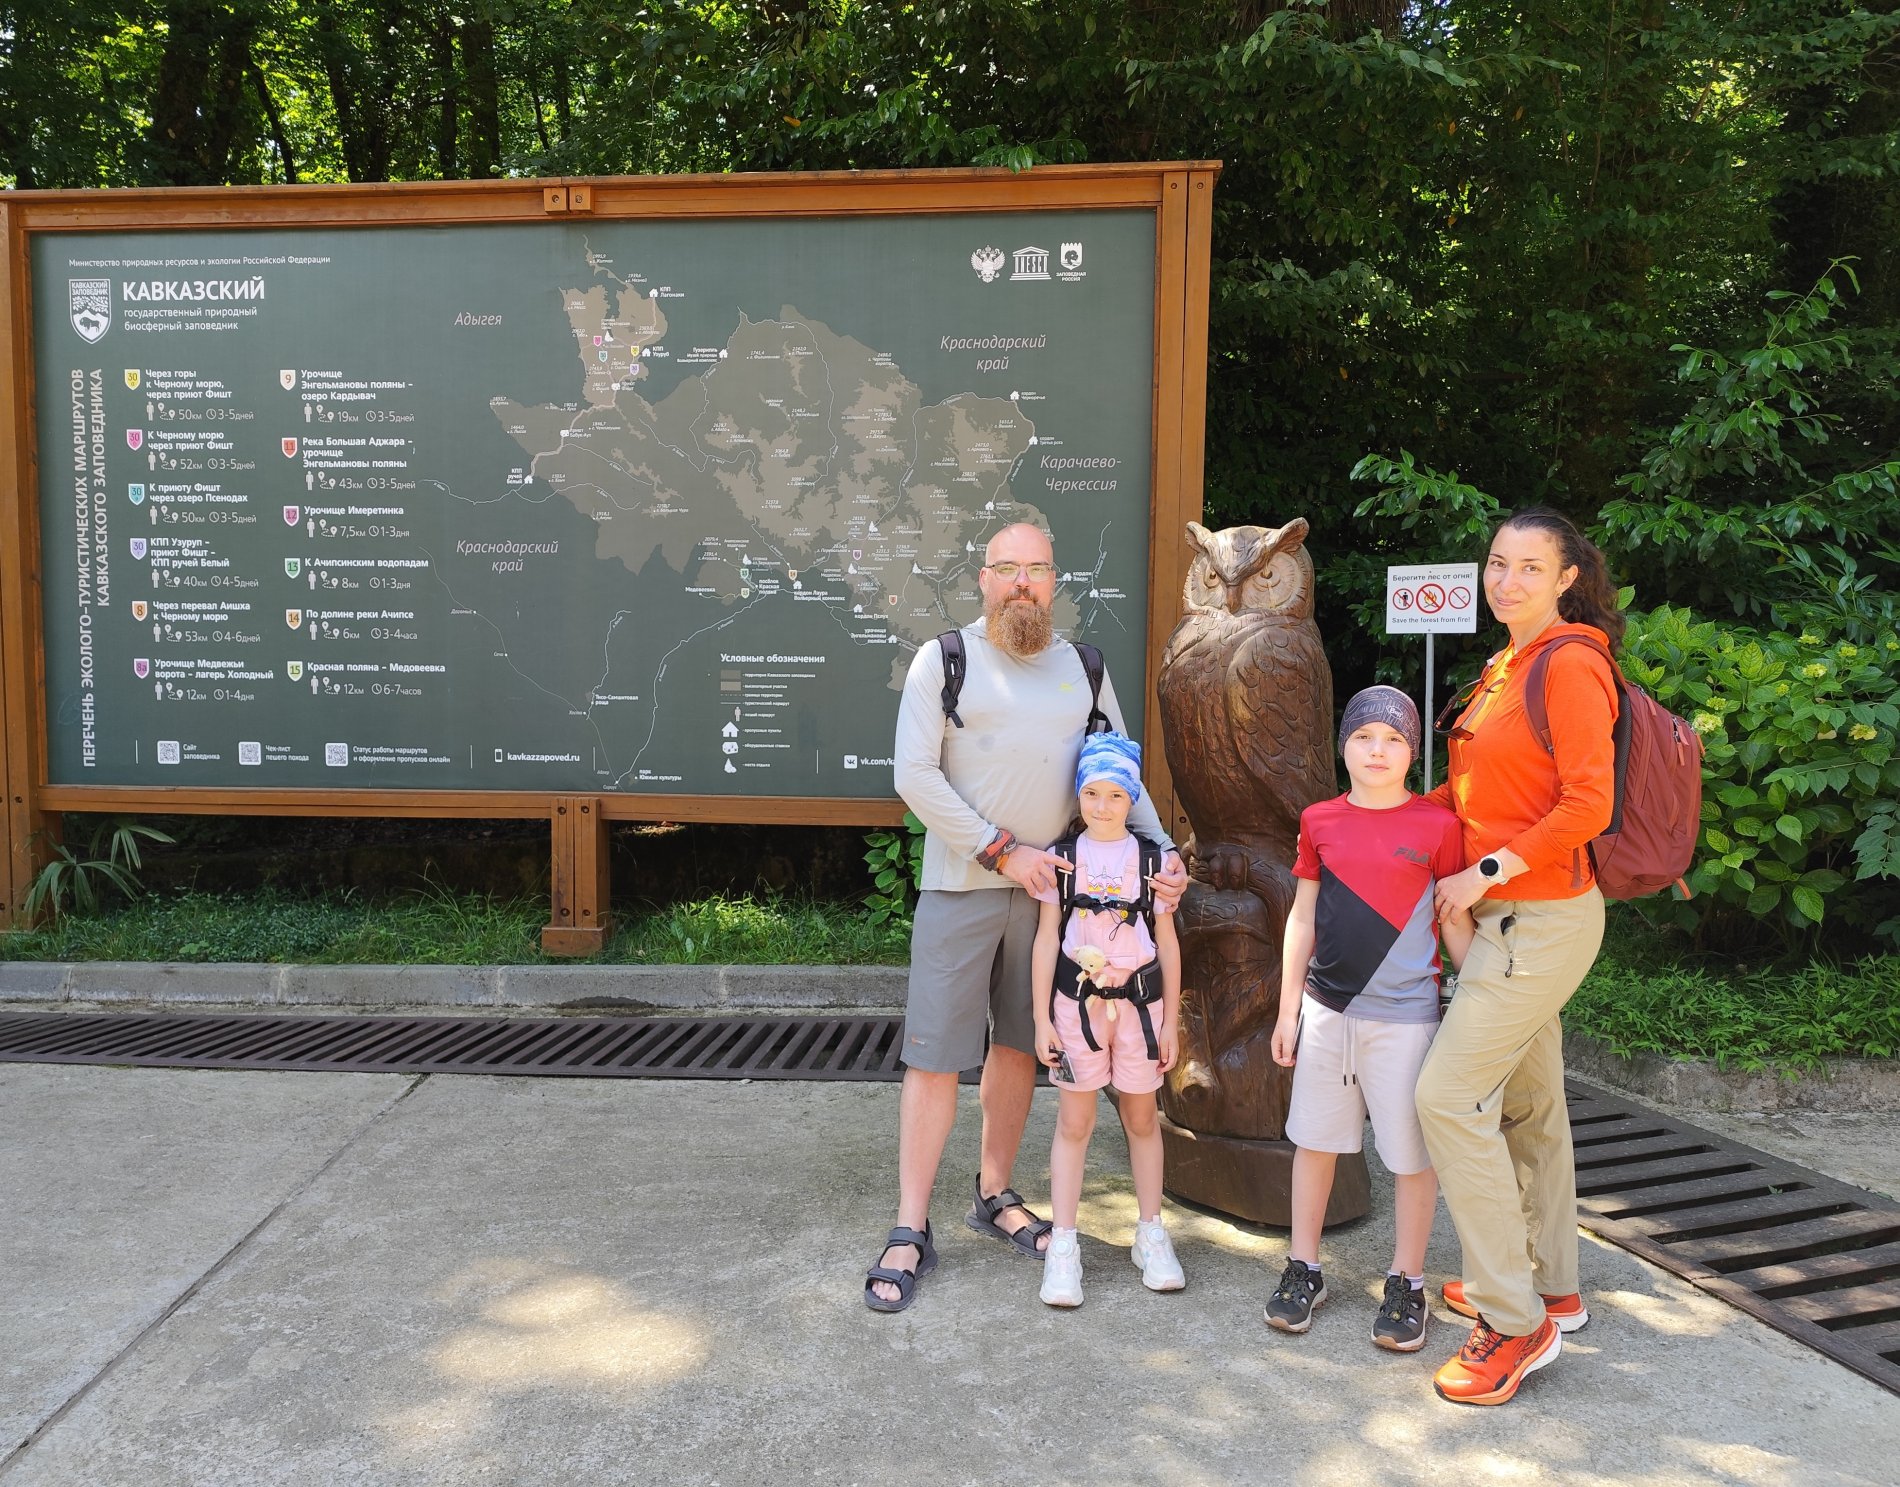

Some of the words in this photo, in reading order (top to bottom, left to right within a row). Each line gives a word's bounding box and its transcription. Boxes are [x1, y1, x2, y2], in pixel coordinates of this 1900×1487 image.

[69, 259, 120, 267] Министерство
[122, 259, 163, 268] природных
[166, 259, 198, 267] ресурсов
[207, 258, 241, 266] экологии
[243, 256, 286, 265] Российской
[288, 256, 331, 265] Федерации
[72, 280, 108, 289] КАВКАЗСКИЙ
[123, 276, 265, 301] КАВКАЗСКИЙ
[124, 308, 202, 318] государственный
[205, 307, 258, 317] природный
[455, 312, 502, 326] Адыгея
[125, 321, 182, 332] биосферный
[185, 322, 239, 331] заповедник
[941, 335, 1047, 352] Краснодарский
[977, 356, 1009, 373] край
[146, 370, 172, 379] Через
[175, 371, 197, 379] горы
[285, 375, 292, 384] 9
[301, 370, 342, 379] Урочище
[154, 380, 194, 389] Черному
[302, 381, 368, 390] Энгельмановы
[371, 381, 406, 389] поляны
[146, 391, 171, 400] через
[174, 391, 204, 400] приют
[206, 390, 232, 399] Фишт
[302, 393, 327, 401] озеро
[331, 392, 376, 401] Кардывач
[71, 369, 87, 471] МАРШРУТОВ
[90, 369, 107, 487] ЗАПОВЕДНИКА
[157, 432, 196, 441] Черному
[199, 432, 224, 441] морю
[148, 443, 173, 451] через
[176, 443, 204, 451] приют
[207, 442, 233, 450] Фишт
[326, 437, 366, 445] Большая
[369, 438, 405, 447] Аджара
[303, 449, 343, 458] урочище
[303, 460, 370, 468] Энгельмановы
[372, 460, 407, 468] поляны
[1040, 455, 1121, 471] Карачаево-
[159, 484, 191, 493] приюту
[194, 483, 221, 492] Фишт
[1046, 479, 1117, 494] Черкессия
[150, 495, 174, 503] через
[177, 495, 203, 503] озеро
[206, 494, 248, 503] Псенодах
[304, 506, 345, 515] Урочище
[348, 506, 404, 515] Имеретинка
[171, 539, 202, 548] Узуруп
[456, 540, 559, 556] Краснодарский
[93, 493, 109, 606] КАВКАЗСКОГО
[151, 550, 179, 558] приют
[182, 549, 209, 557] Фишт
[151, 559, 170, 567] КПП
[172, 558, 198, 568] ручей
[201, 558, 230, 567] Белый
[315, 558, 375, 567] Ачипсинским
[378, 559, 428, 568] водопадам
[492, 559, 523, 574] край
[75, 476, 93, 688] ЭКОЛОГО-ТУРИСТИЧЕСКИХ
[153, 602, 179, 611] Через
[182, 603, 217, 611] перевал
[220, 602, 250, 610] Аишха
[161, 613, 200, 622] Черному
[203, 613, 228, 622] морю
[306, 610, 318, 618] По
[321, 611, 354, 620] долине
[357, 611, 378, 620] реки
[381, 610, 414, 619] Ачипсе
[721, 654, 764, 663] Условные
[767, 654, 825, 663] обозначения
[155, 660, 194, 669] Урочище
[198, 659, 244, 668] Медвежьи
[308, 663, 344, 672] Красная
[347, 664, 379, 672] поляна
[389, 664, 446, 673] Медовеевка
[155, 671, 185, 679] ворота
[195, 671, 225, 680] лагерь
[228, 670, 274, 679] Холодный
[82, 692, 95, 767] ПЕРЕЧЕНЬ
[353, 746, 372, 754] Статус
[373, 746, 394, 754] работы
[507, 752, 580, 764] kavkazzapoved.ru
[1393, 847, 1429, 864] FILA
